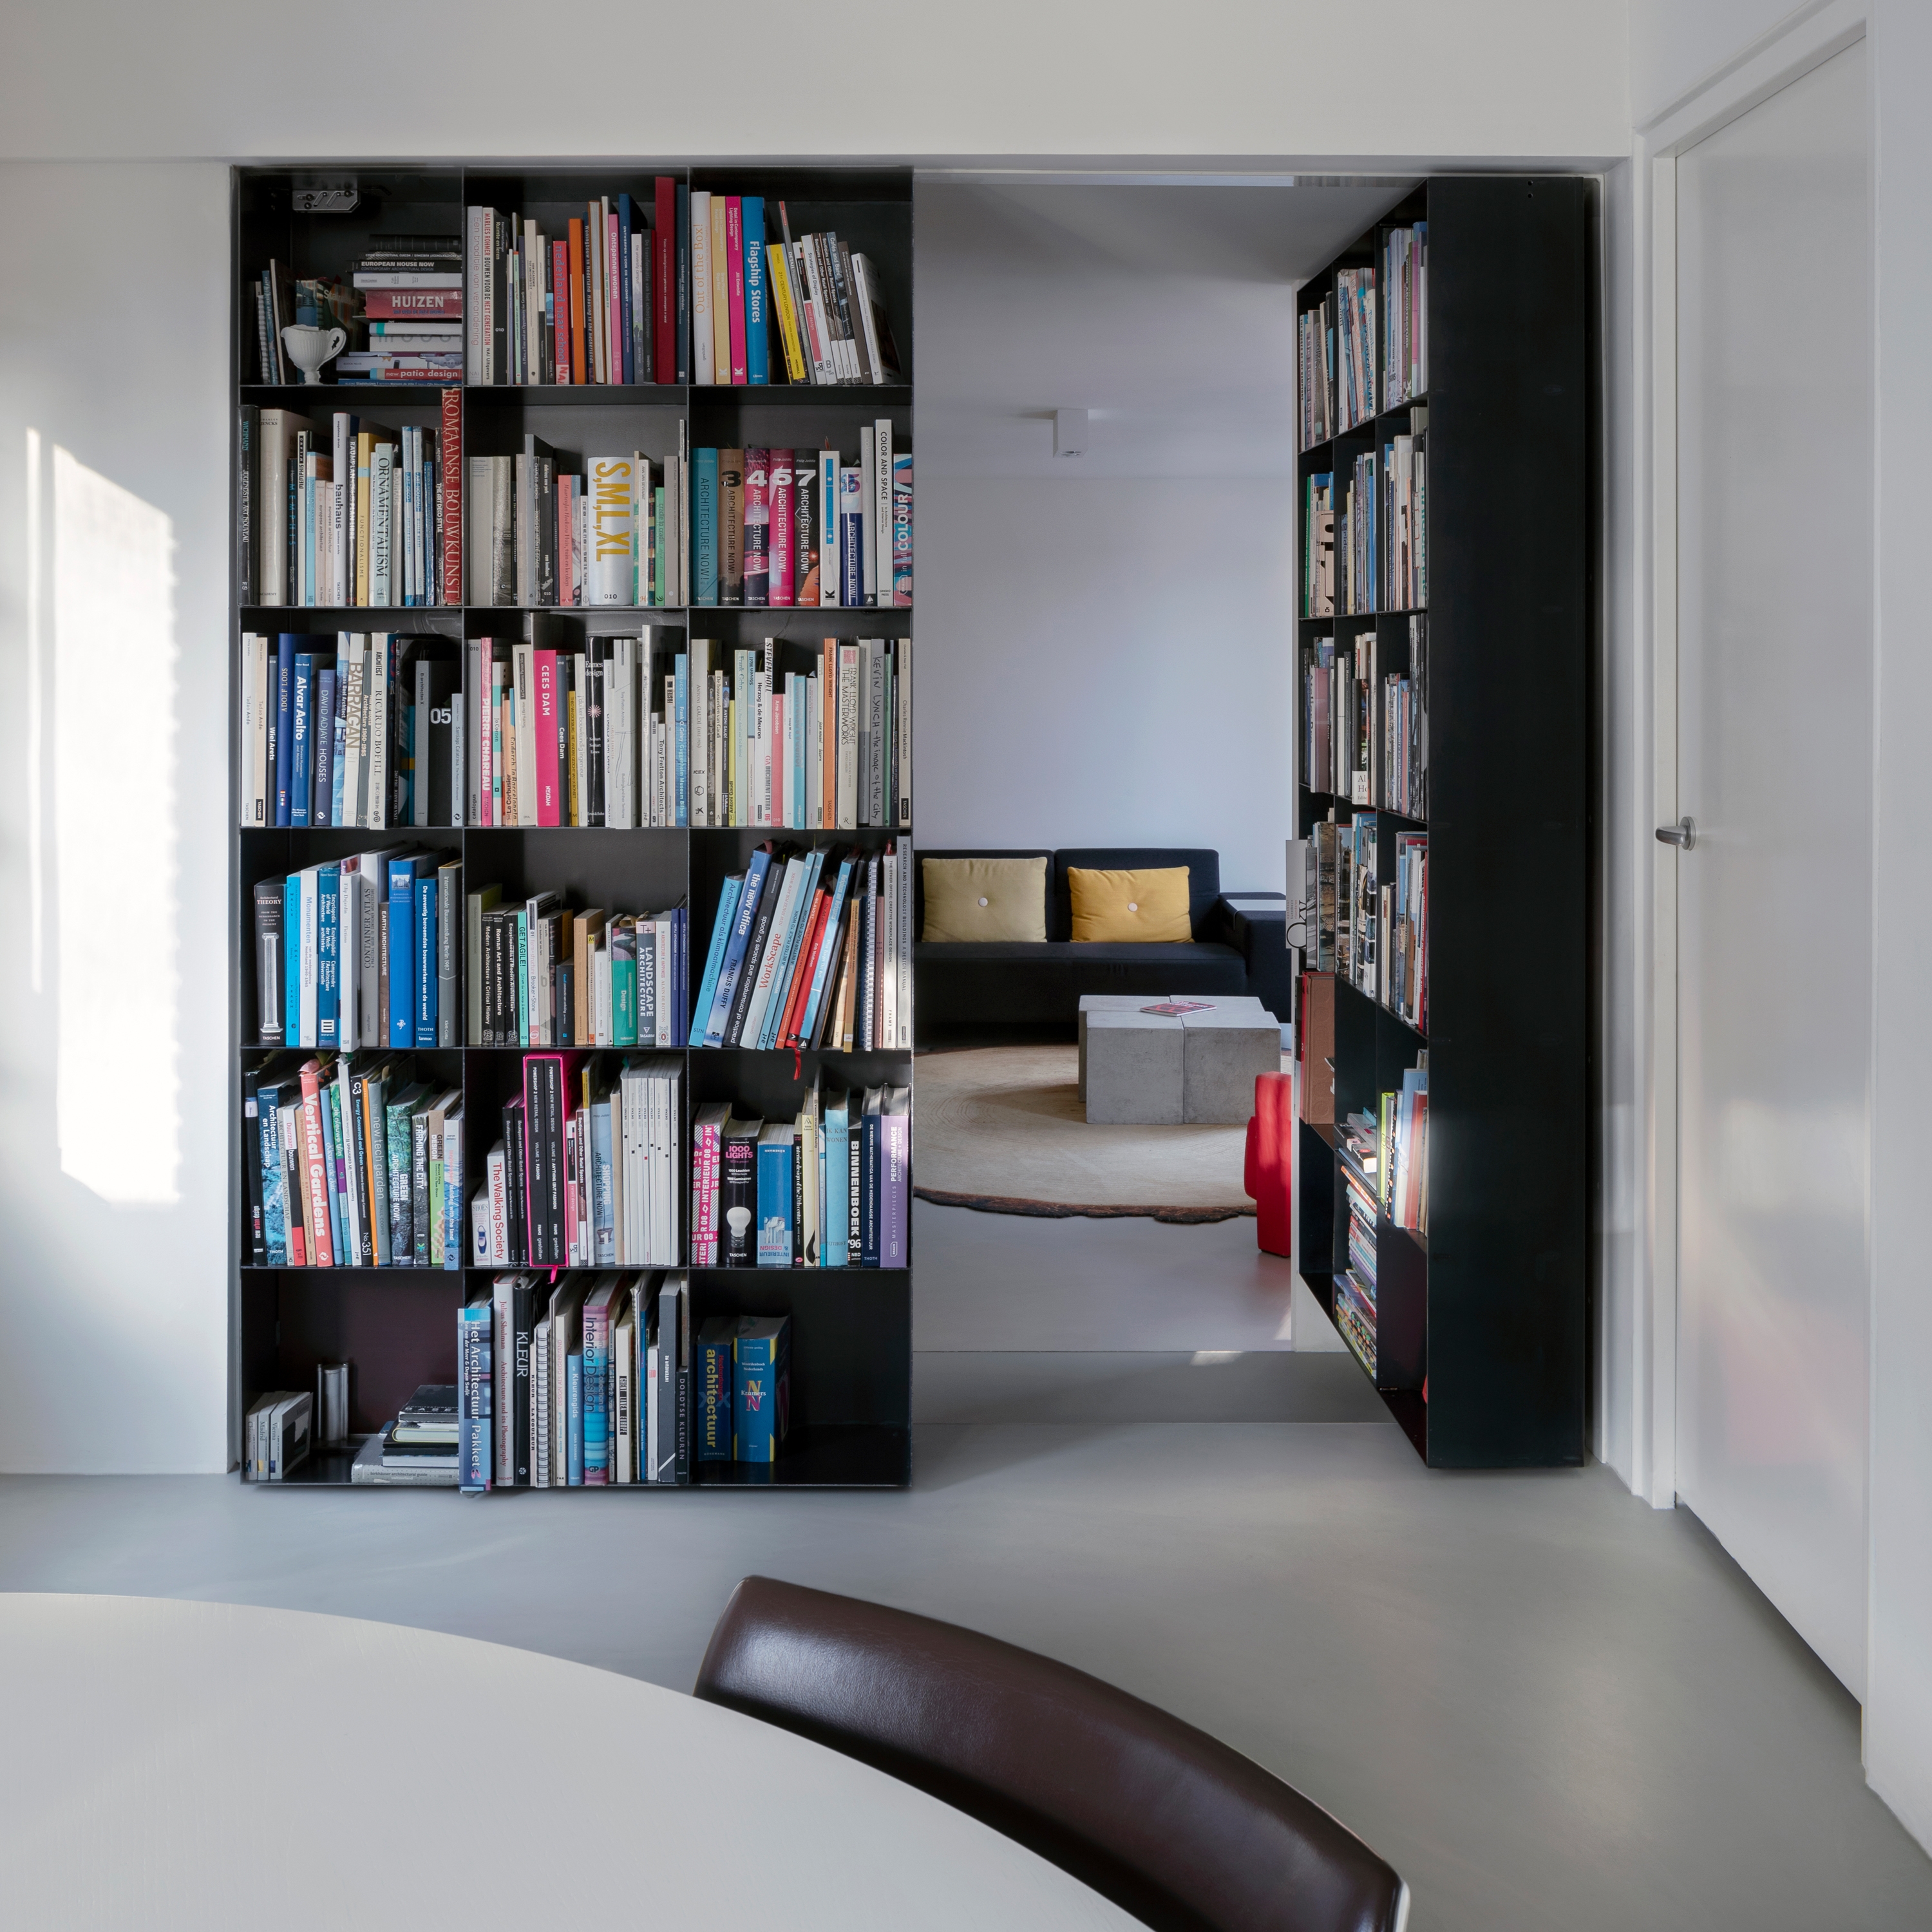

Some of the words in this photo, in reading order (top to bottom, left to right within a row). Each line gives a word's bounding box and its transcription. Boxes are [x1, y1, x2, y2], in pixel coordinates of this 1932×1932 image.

[694, 224, 704, 250] Box!
[555, 246, 564, 302] nederland
[695, 254, 705, 273] the
[748, 241, 761, 286] Flagship
[695, 276, 705, 288] of
[779, 280, 788, 301] CENTURY
[392, 296, 444, 308] HUIZEN
[696, 292, 705, 313] Out
[752, 290, 761, 323] Stores
[782, 301, 791, 320] LONDON
[557, 332, 567, 363] school
[444, 394, 460, 484] ROMAANSE
[376, 458, 390, 578] ORNAMENTALISM
[592, 462, 631, 562] S,M,L,XL
[700, 478, 710, 550] ARCHITECTURE
[778, 488, 786, 548] ARCHITECTURE
[800, 488, 809, 549] ARCHITECTURE
[898, 494, 909, 551] COLOUR
[444, 489, 460, 598] BOUWKUNST
[701, 554, 710, 580] NOW!
[778, 551, 786, 572] NOW!
[800, 551, 809, 574] NOW!
[296, 676, 307, 708] Alvar
[542, 665, 550, 689] CEES
[295, 709, 306, 741] Aalto
[430, 708, 451, 724] 05
[872, 695, 882, 727] LYNCH
[319, 716, 328, 745] ADJAYE
[318, 748, 327, 782] HOUSES
[872, 750, 880, 772] image
[873, 775, 881, 785] of
[750, 873, 761, 887] the
[721, 883, 736, 926] Architectuur
[745, 889, 757, 909] new
[717, 927, 726, 937] als
[738, 909, 750, 935] office
[706, 938, 724, 992] klimaatmachine
[724, 959, 737, 987] FRANCIS
[759, 933, 781, 989] WorkScape
[645, 947, 654, 1017] LANDSCAPE
[719, 988, 730, 1009] DUFFY
[262, 1118, 268, 1127] en
[269, 1105, 278, 1149] Architectuur
[304, 1093, 323, 1160] Vertical
[373, 1117, 381, 1138] new
[374, 1139, 383, 1162] tech
[373, 1164, 386, 1199] garden
[400, 1174, 408, 1200] GREEN
[493, 1162, 502, 1181] The
[602, 1164, 611, 1205] SHOPPING
[310, 1164, 327, 1237] Gardens
[493, 1182, 504, 1220] Walking
[851, 1141, 859, 1236] BINNENBOEK
[494, 1222, 504, 1259] Society
[471, 1321, 481, 1343] Het
[585, 1317, 596, 1363] Interior
[516, 1331, 528, 1377] KLEUR
[471, 1346, 482, 1420] Architectuur
[583, 1366, 596, 1413] Design
[706, 1349, 718, 1448] architectuur
[471, 1425, 482, 1467] Pakket
